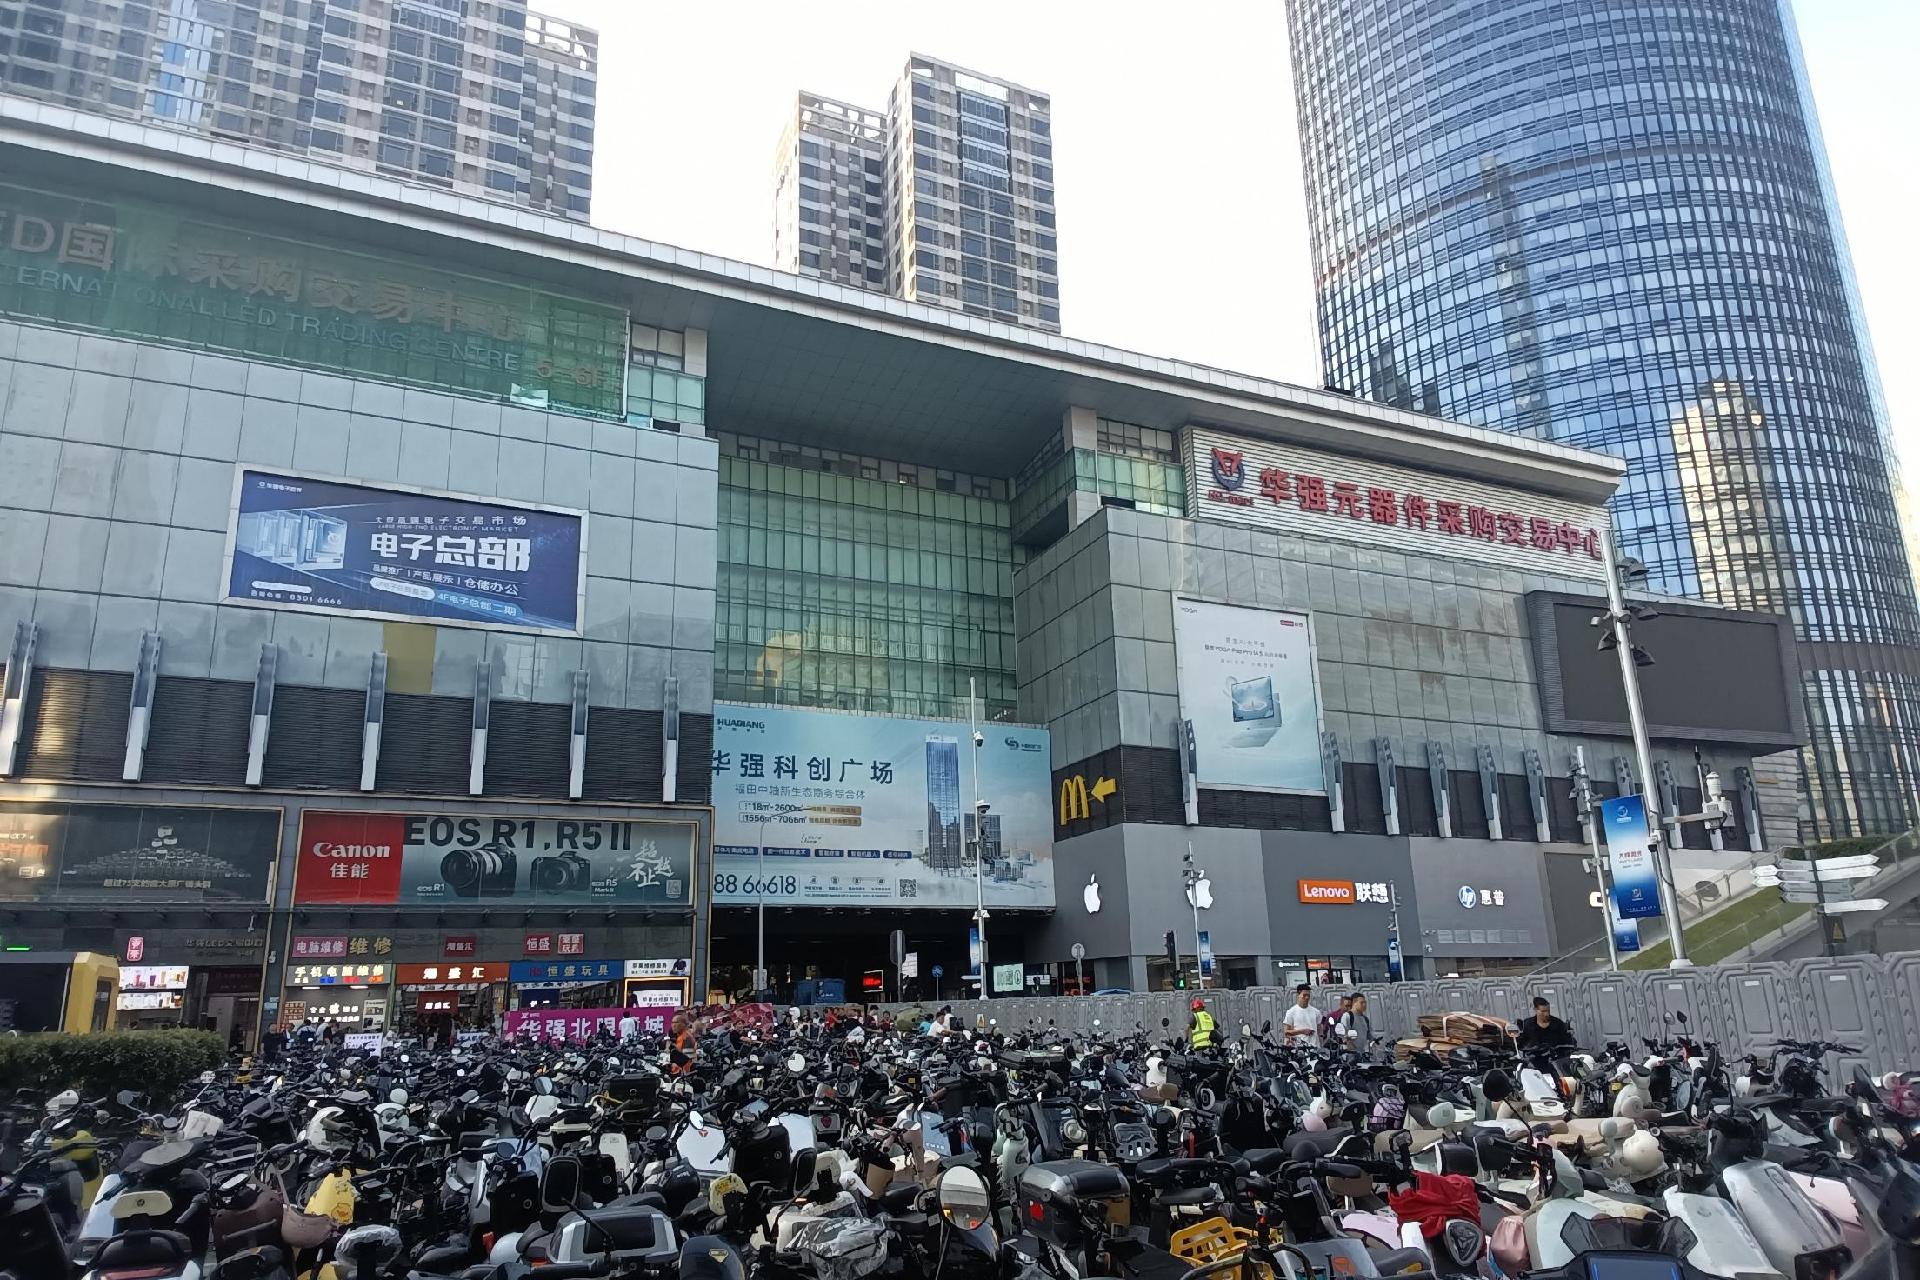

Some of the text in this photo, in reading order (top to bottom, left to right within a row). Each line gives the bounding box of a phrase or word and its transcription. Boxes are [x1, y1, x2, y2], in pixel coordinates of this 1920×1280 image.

[286, 311, 407, 350] TRADING
[415, 336, 521, 371] CENTRE
[370, 532, 531, 572] 电子总部
[712, 750, 893, 785] 华强科创广场
[405, 816, 481, 847] EOS
[313, 842, 390, 858] Canon
[330, 862, 370, 879] 佳能
[742, 874, 797, 895] 66618
[1303, 883, 1350, 898] Lenovo
[1355, 882, 1389, 904] 联想
[1480, 889, 1504, 906] 惠普
[349, 937, 392, 955] 维修
[527, 937, 550, 951] 恒盛
[547, 964, 609, 977] 恒盛玩具
[517, 1015, 664, 1039] 华强北眼城
